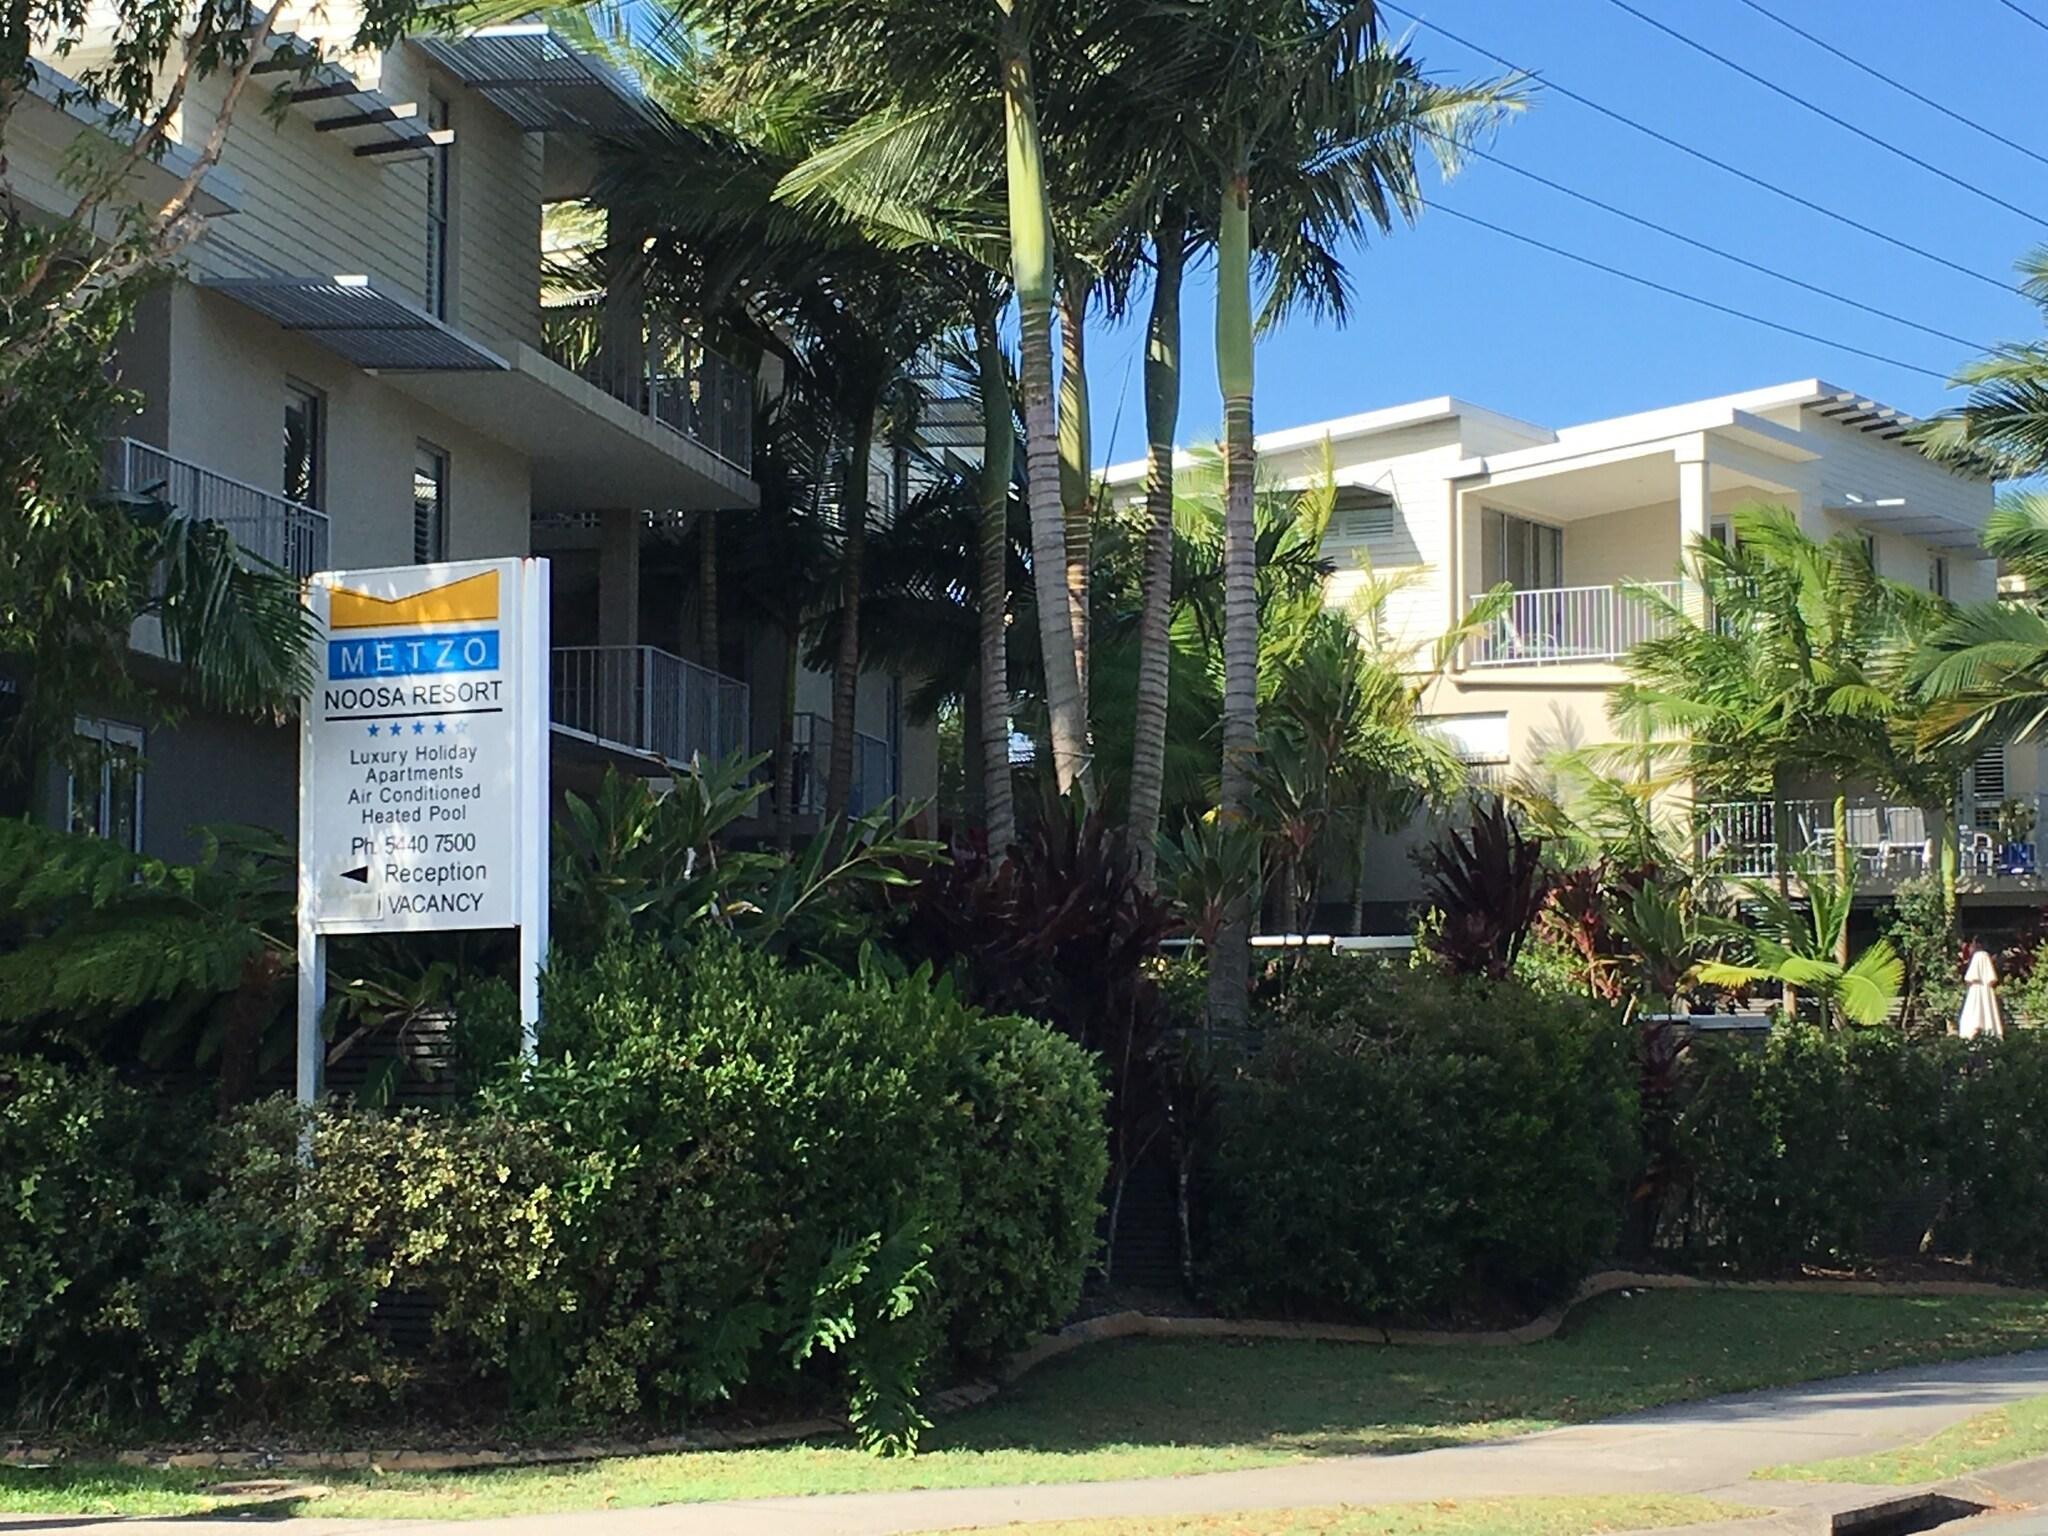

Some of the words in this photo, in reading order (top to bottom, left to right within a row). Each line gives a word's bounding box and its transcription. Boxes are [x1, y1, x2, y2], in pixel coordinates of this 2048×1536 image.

[341, 638, 487, 672] METZO
[325, 687, 406, 710] NOOSA
[413, 681, 503, 705] RESORT
[351, 748, 407, 765] Luxury
[416, 745, 477, 763] Holiday
[366, 766, 463, 784] Apartments
[348, 789, 373, 804] Air
[379, 785, 480, 803] Conditioned
[362, 807, 420, 824] Heated
[430, 805, 466, 821] Pool
[385, 835, 428, 854] 5440
[435, 833, 476, 852] 7500
[385, 862, 487, 885] Reception
[389, 893, 484, 914] VACANCY
